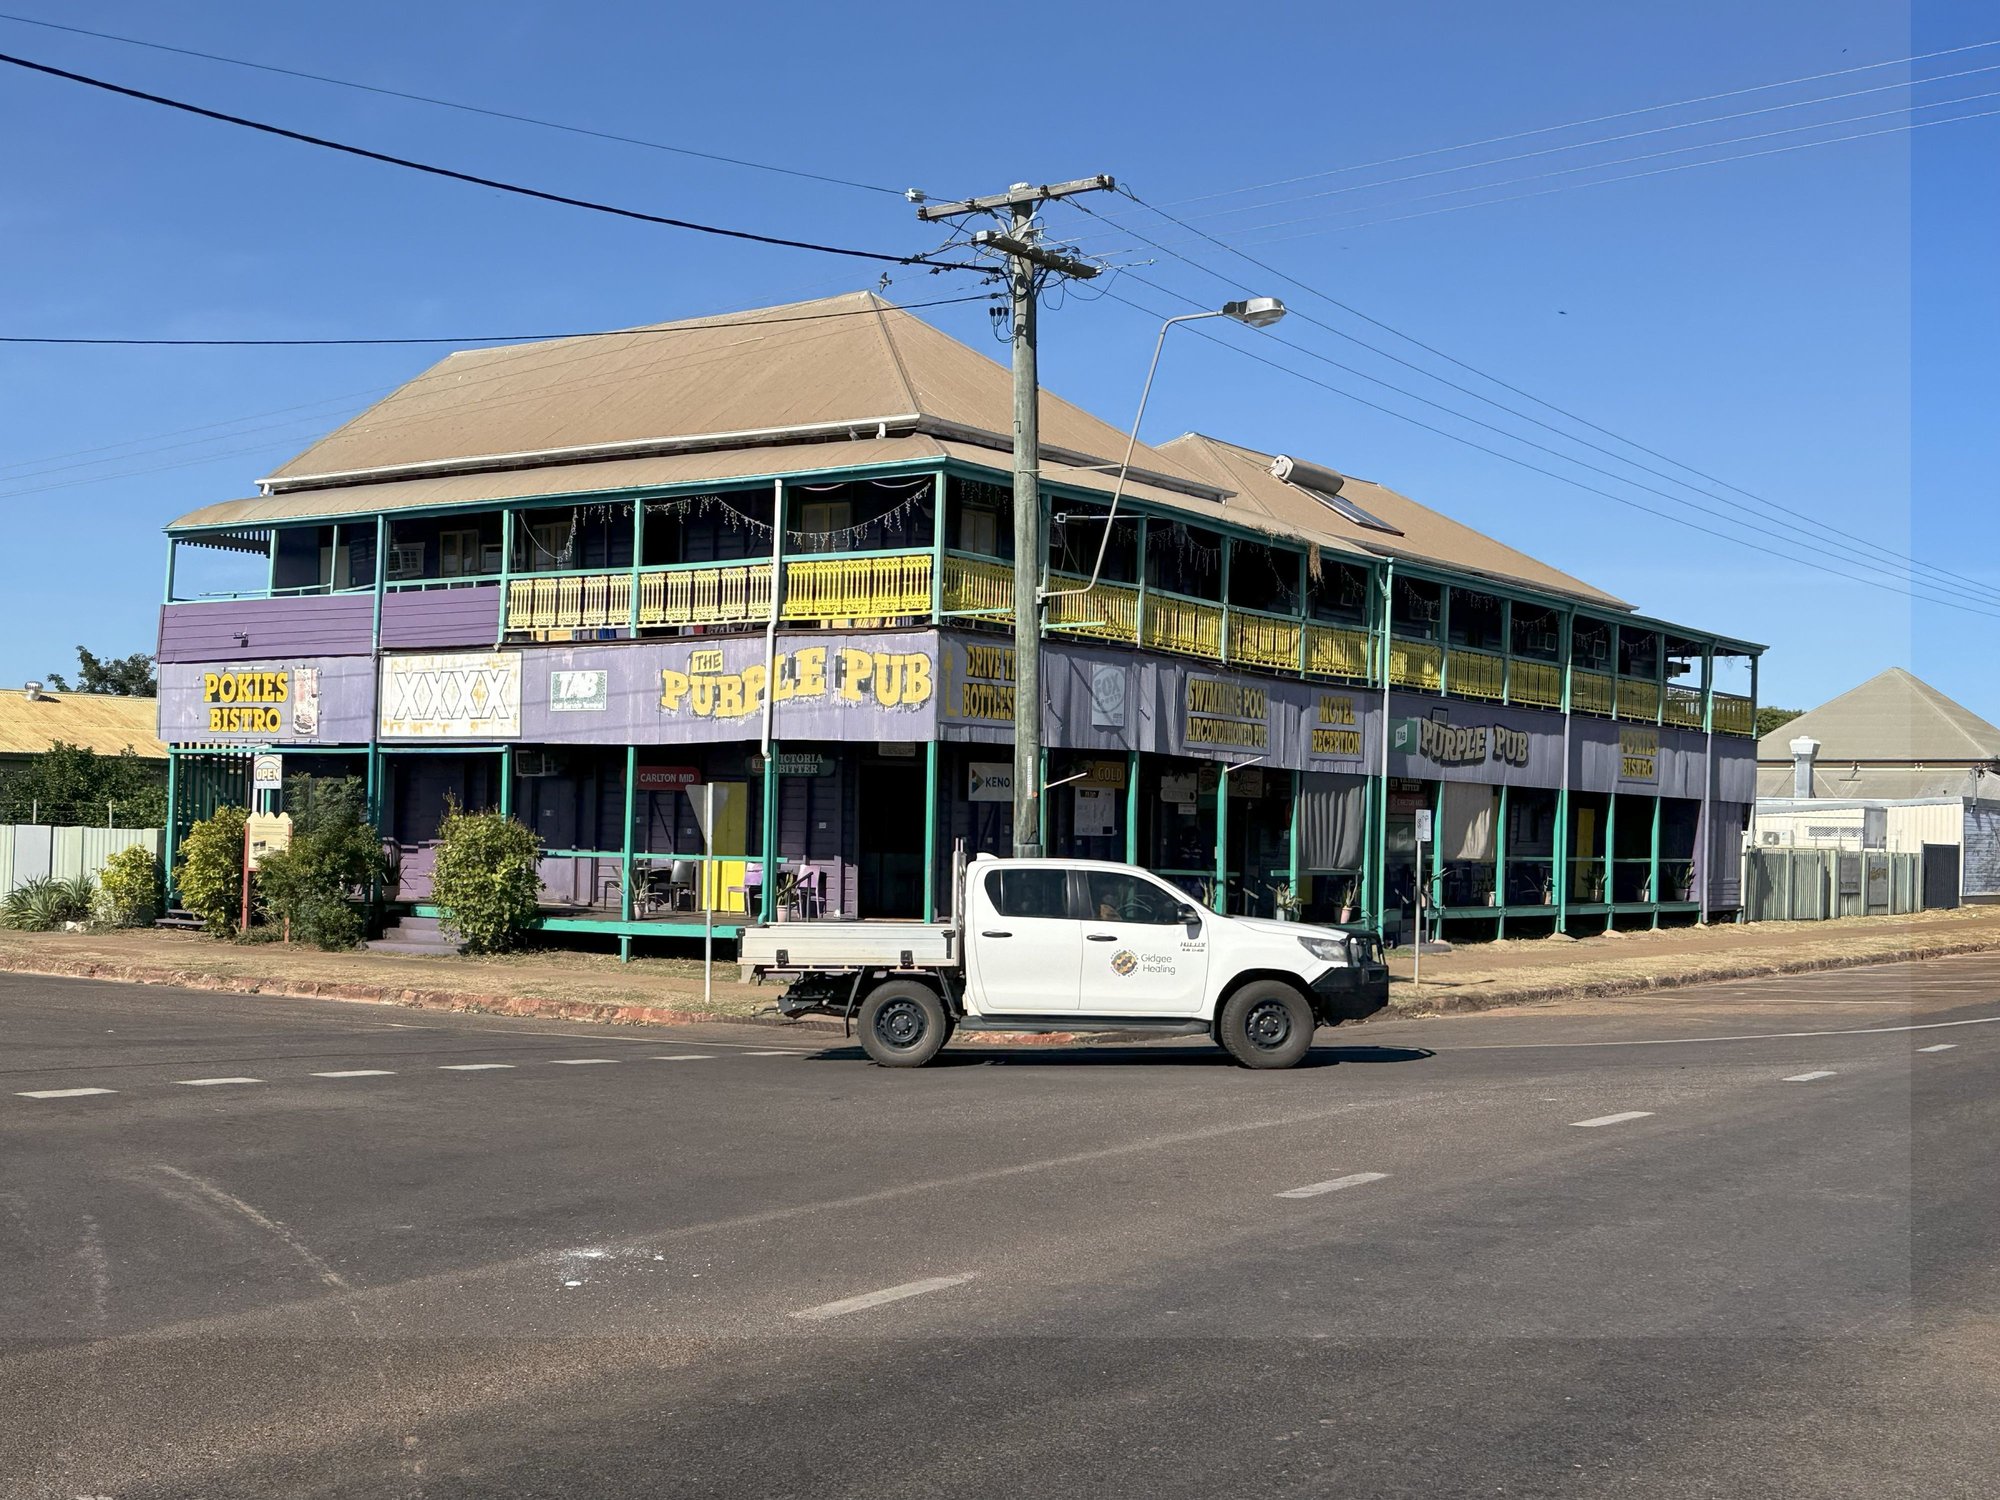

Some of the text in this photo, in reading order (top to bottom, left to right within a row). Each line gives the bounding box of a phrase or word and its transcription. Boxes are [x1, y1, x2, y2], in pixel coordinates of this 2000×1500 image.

[695, 652, 721, 671] THE
[966, 644, 1002, 680] DRIVE
[203, 671, 289, 703] POKIES
[393, 669, 511, 720] XXXX
[558, 671, 599, 699] TAB
[660, 646, 932, 719] PURPLE PUB
[1093, 671, 1121, 700] FOX
[1187, 678, 1269, 720] SWIMMING POOL
[1318, 695, 1356, 726] MOTEL
[208, 707, 282, 734] BISTRO
[1185, 716, 1254, 748] AIRCONDITIONED
[1311, 728, 1361, 755] RECEPTION
[1420, 716, 1528, 766] PURPLE PUB
[778, 753, 824, 763] ICTORIA
[778, 764, 819, 774] BITTER
[1621, 757, 1654, 778] BISTRO
[255, 767, 281, 782] OPEN
[640, 773, 695, 783] CARLTON MID
[985, 776, 1011, 788] KENO
[1098, 767, 1122, 781] GOLD
[1140, 953, 1173, 965] Gidgee
[1142, 964, 1176, 976] Healing
